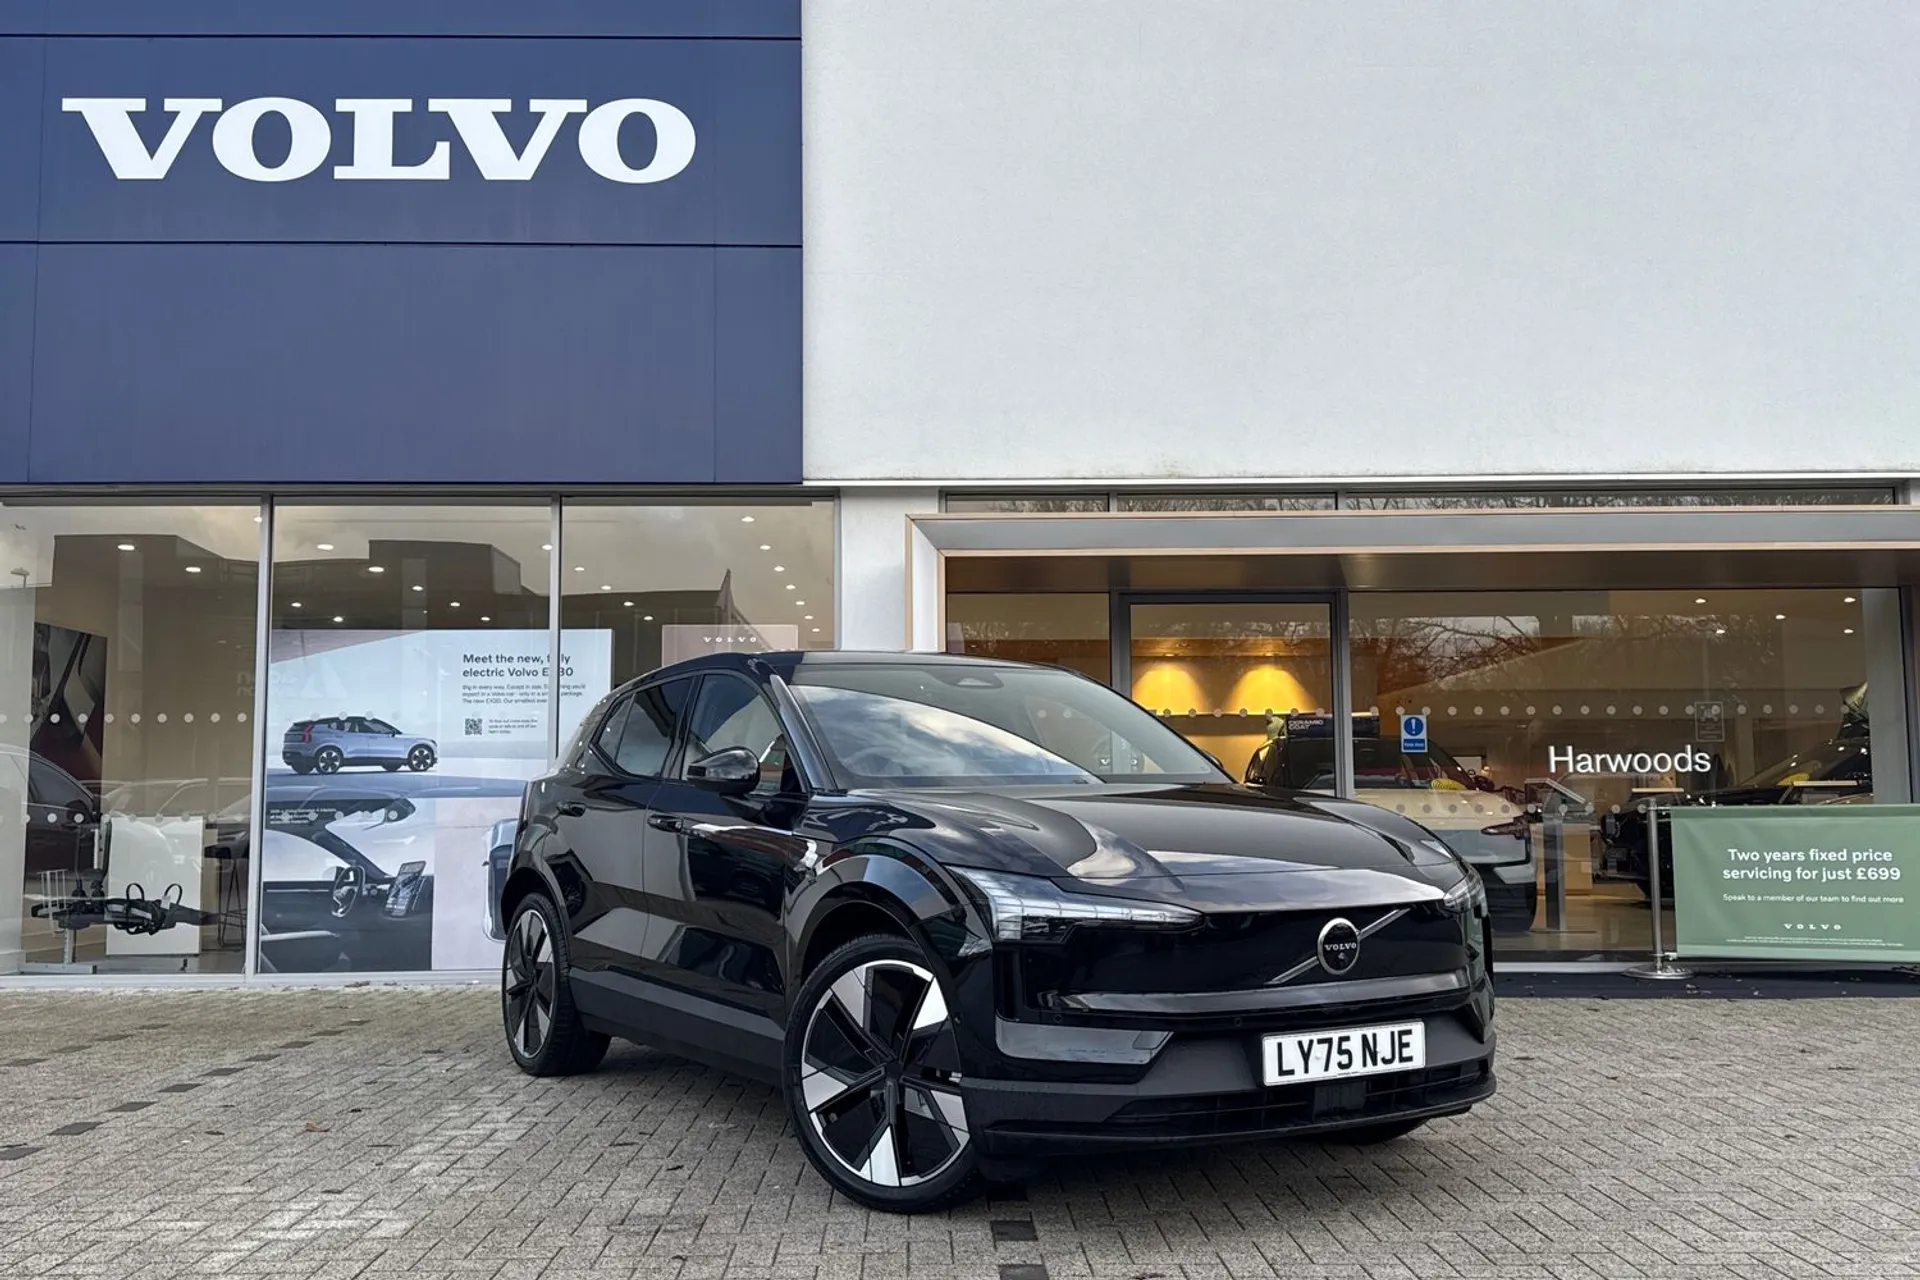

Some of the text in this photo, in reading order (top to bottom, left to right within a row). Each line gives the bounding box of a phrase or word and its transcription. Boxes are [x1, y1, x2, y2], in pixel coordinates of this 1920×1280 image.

[61, 97, 696, 183] VOLVO
[463, 653, 571, 665] Meet the new, fly
[462, 667, 574, 677] electric Volvo E30
[1548, 744, 1712, 773] Harwoods
[1727, 848, 1893, 864] Two years fixed price
[1723, 867, 1901, 883] servicing for just £699
[1723, 893, 1746, 902] Speak
[1747, 894, 1756, 902] to
[1763, 894, 1795, 902] member
[1796, 894, 1805, 902] of
[1851, 895, 1866, 903] find
[1324, 943, 1357, 951] VOLVO
[1277, 1029, 1414, 1077] LY75 NJE
